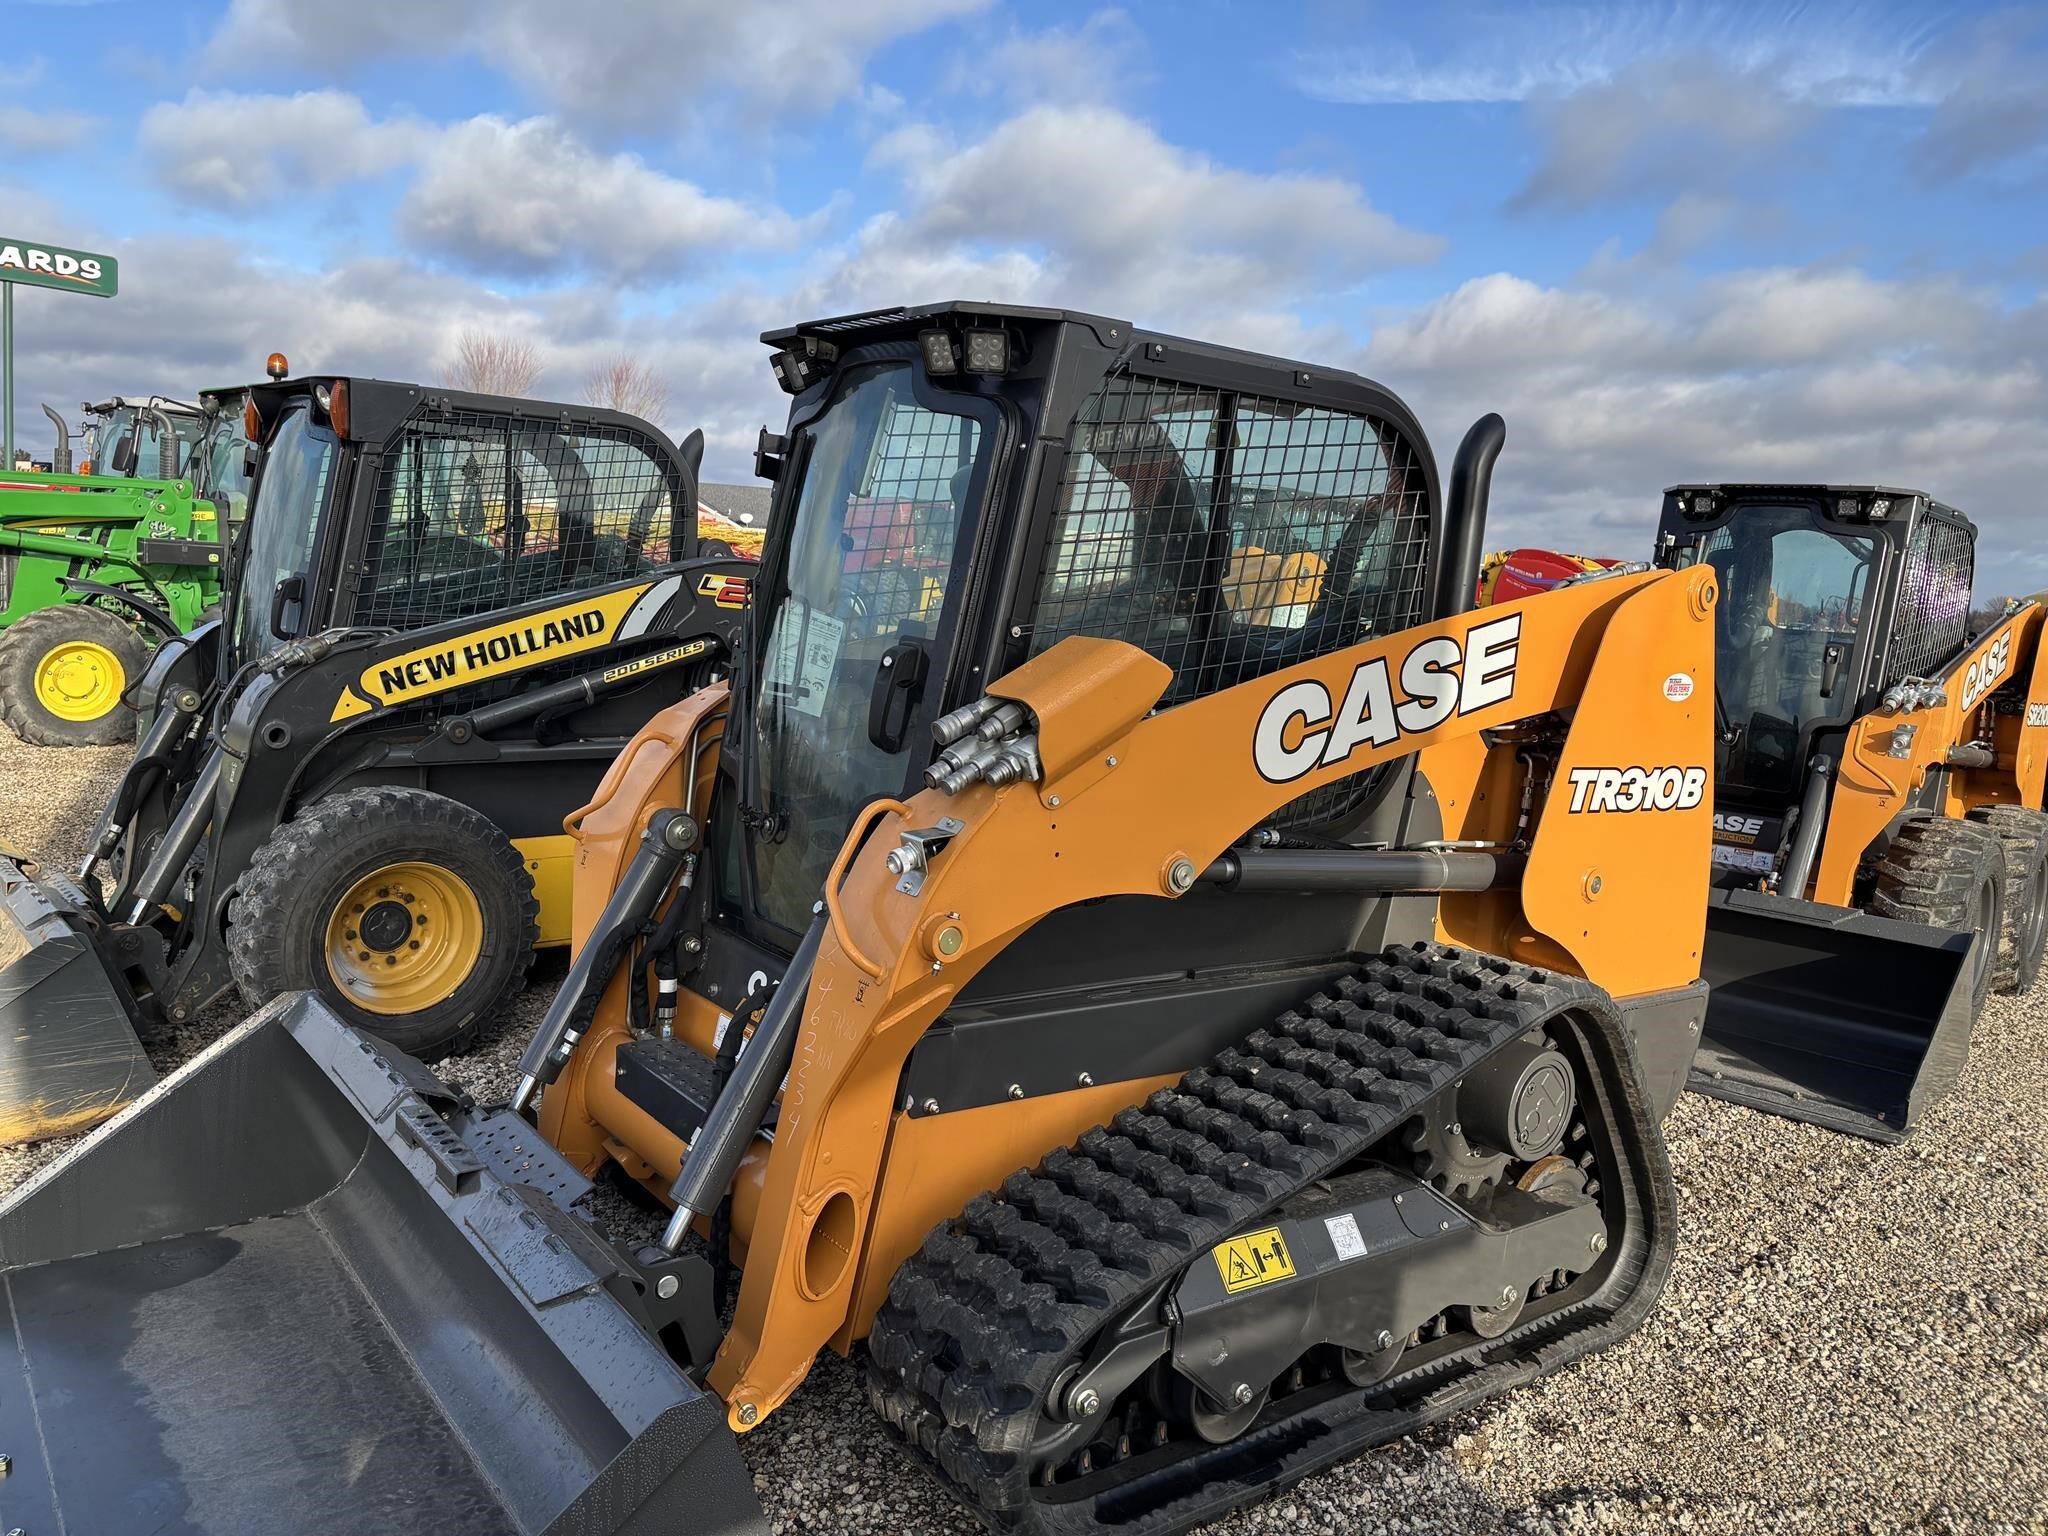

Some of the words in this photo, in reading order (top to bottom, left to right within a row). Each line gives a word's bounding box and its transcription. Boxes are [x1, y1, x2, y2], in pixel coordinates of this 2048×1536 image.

[0, 246, 101, 279] ARDS
[379, 652, 457, 695] NEW
[463, 609, 605, 670] HOLLAND
[605, 662, 640, 681] 200
[645, 641, 704, 667] SERIES
[1961, 626, 2012, 712] CASE
[1253, 612, 1522, 784] CASE
[1568, 765, 1707, 814] TR310B
